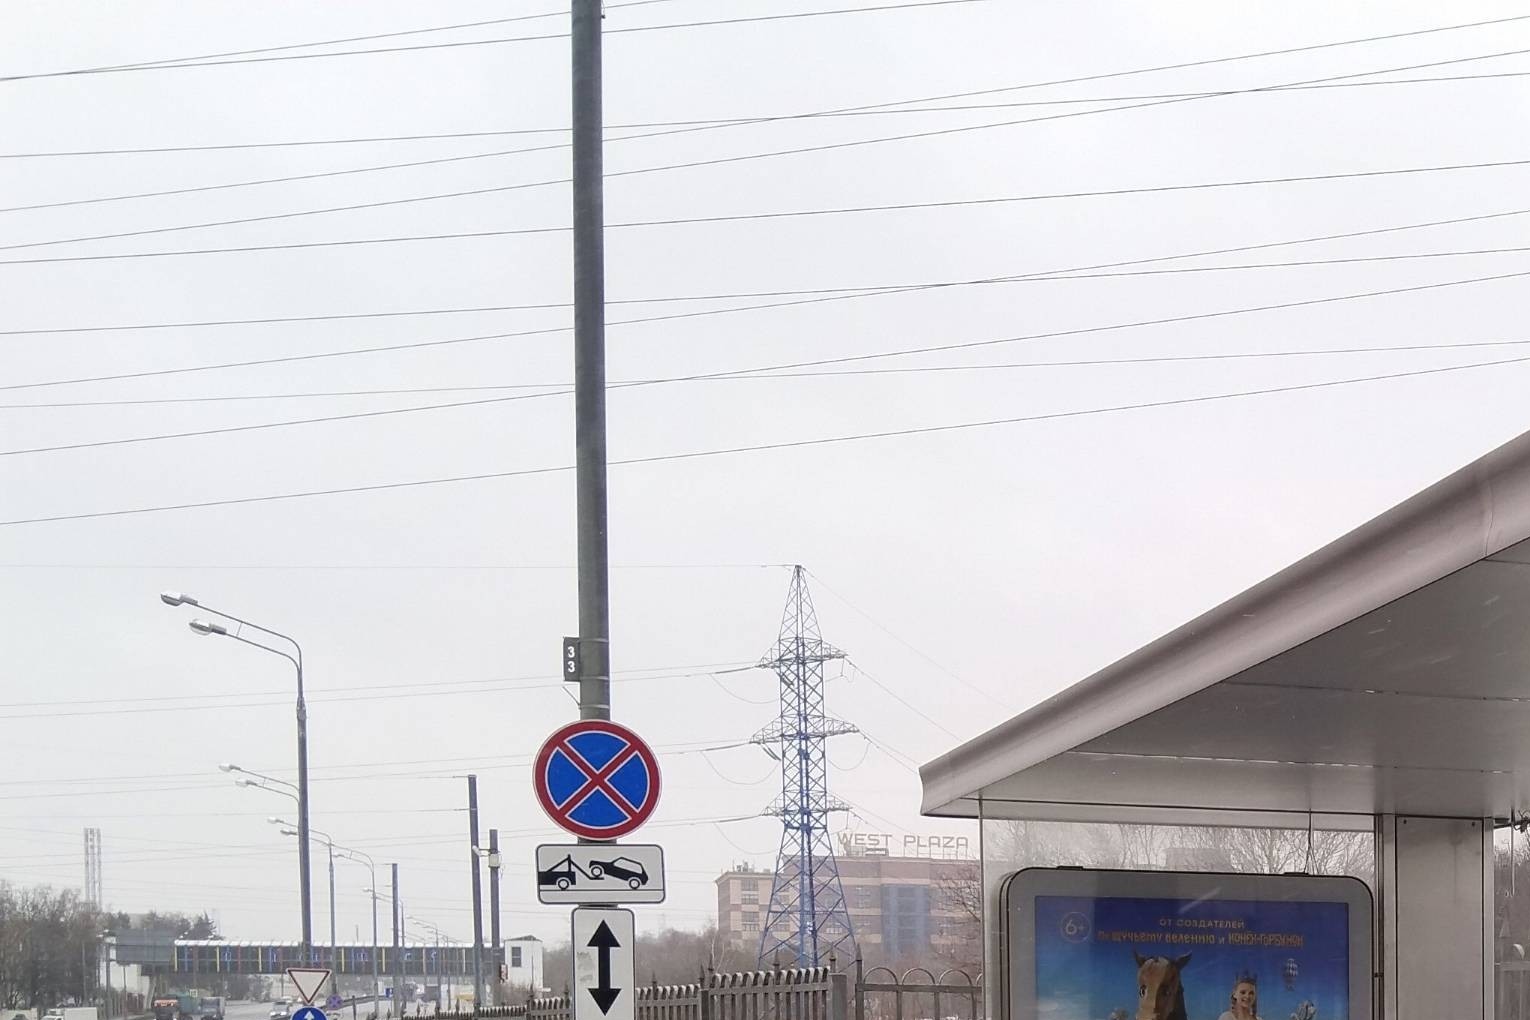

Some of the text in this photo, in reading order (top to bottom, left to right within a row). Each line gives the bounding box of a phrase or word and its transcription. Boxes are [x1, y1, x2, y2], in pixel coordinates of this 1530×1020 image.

[837, 833, 969, 850] WEST PLAZA
[1065, 918, 1086, 935] 6+
[1159, 918, 1245, 929] ОТ СОЗДАТЕЛЕЙ
